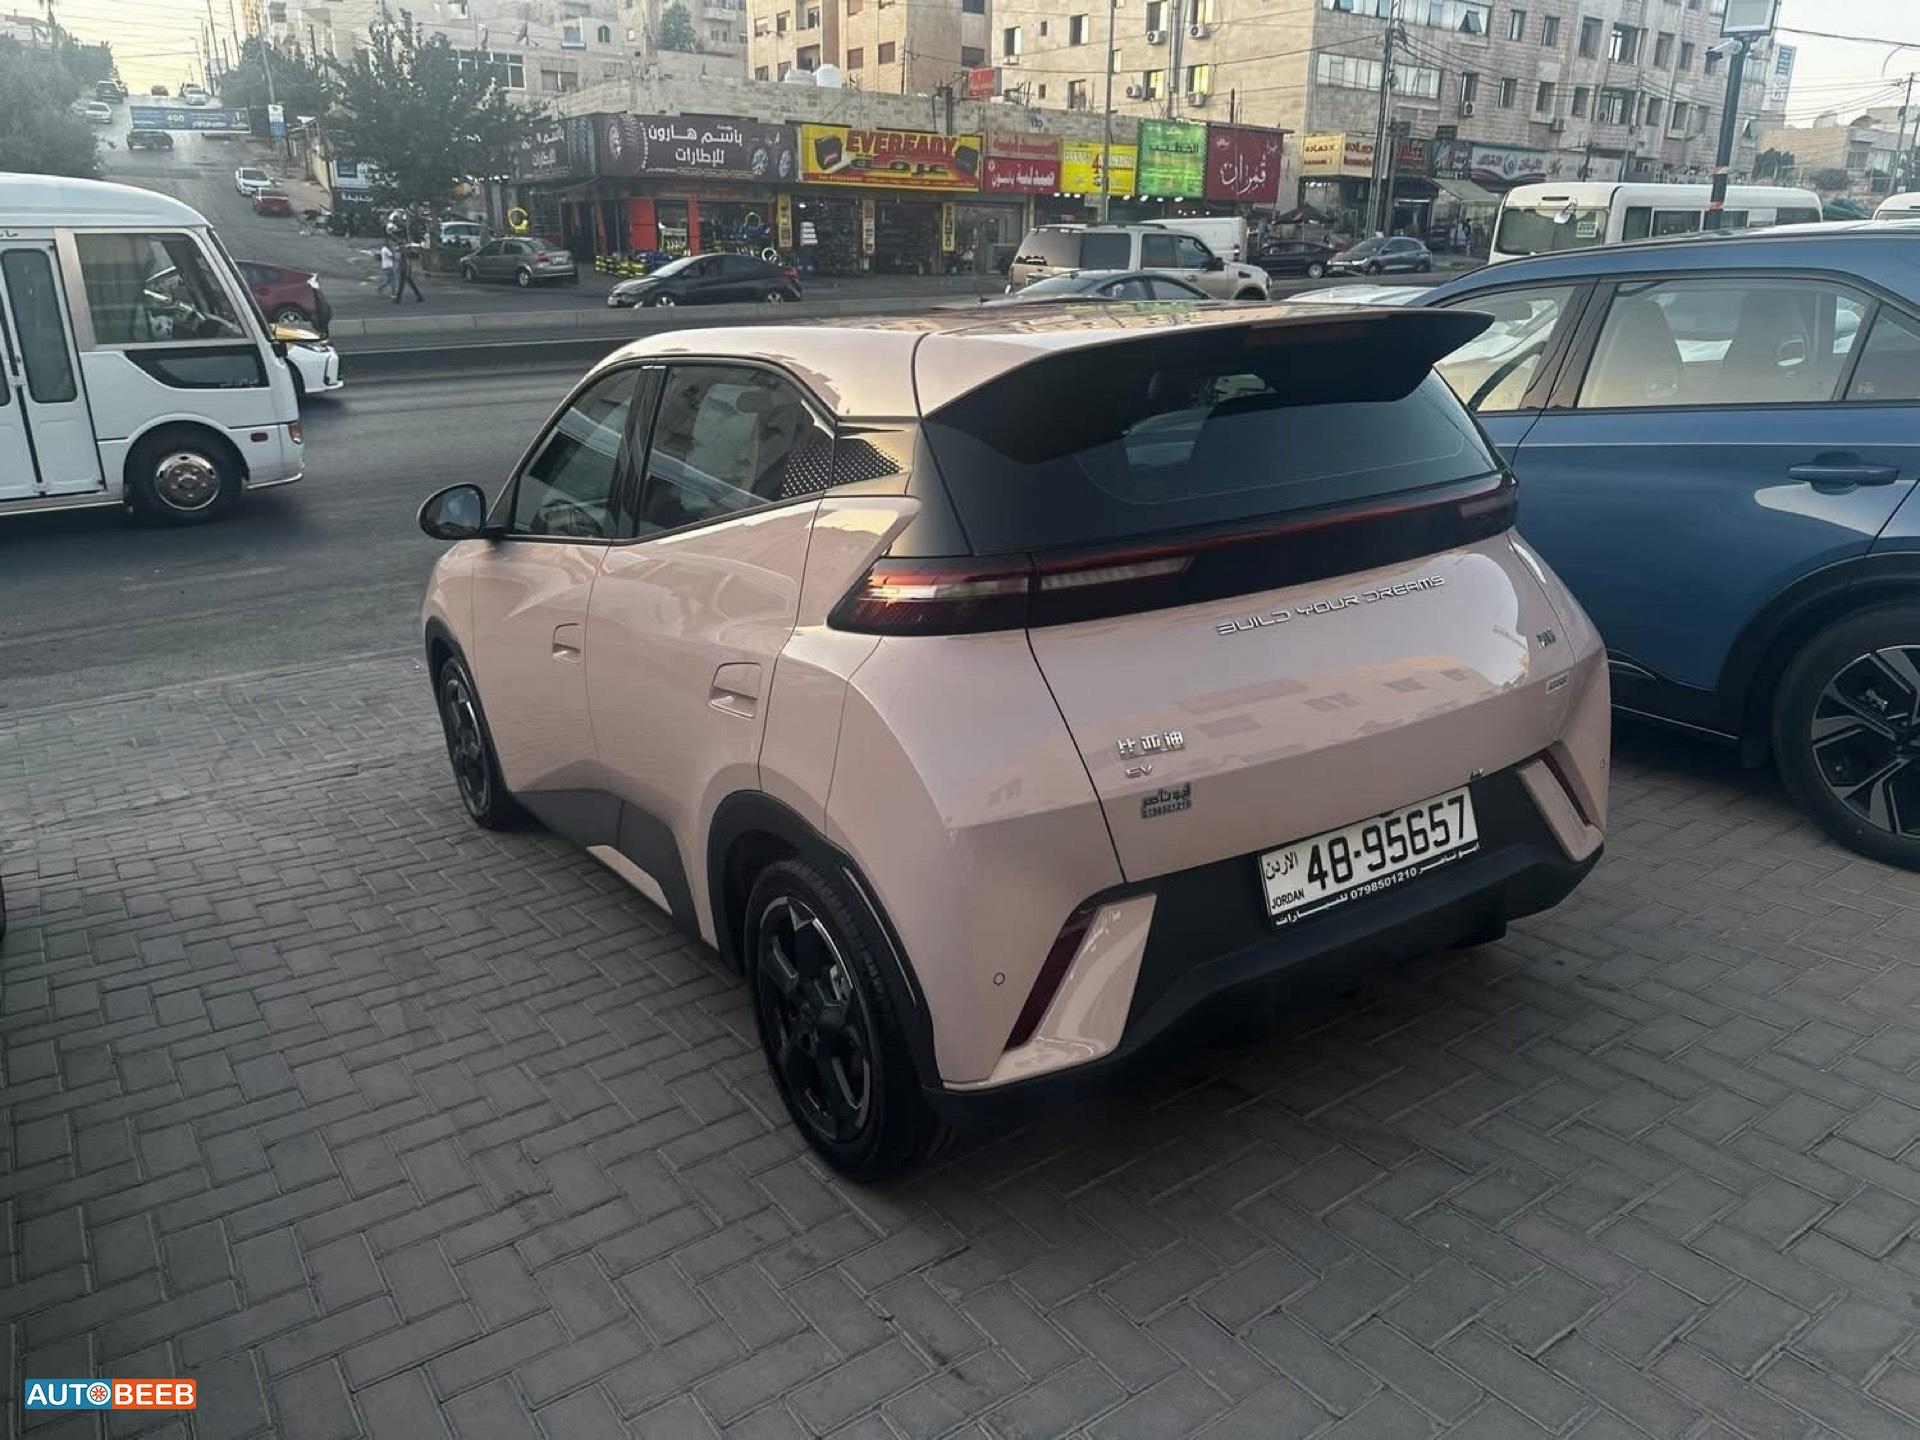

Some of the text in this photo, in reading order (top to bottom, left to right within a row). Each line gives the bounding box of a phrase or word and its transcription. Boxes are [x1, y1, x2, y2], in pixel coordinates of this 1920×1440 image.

[648, 124, 743, 147] باسم هارون
[846, 129, 958, 155] EVEREADY
[675, 146, 725, 167] للإطارات
[1216, 575, 1446, 636] BUILD YOUR DREAMS
[1307, 794, 1466, 891] 48-95657
[1350, 867, 1418, 901] 0798501210
[1271, 888, 1305, 910] JORDAN
